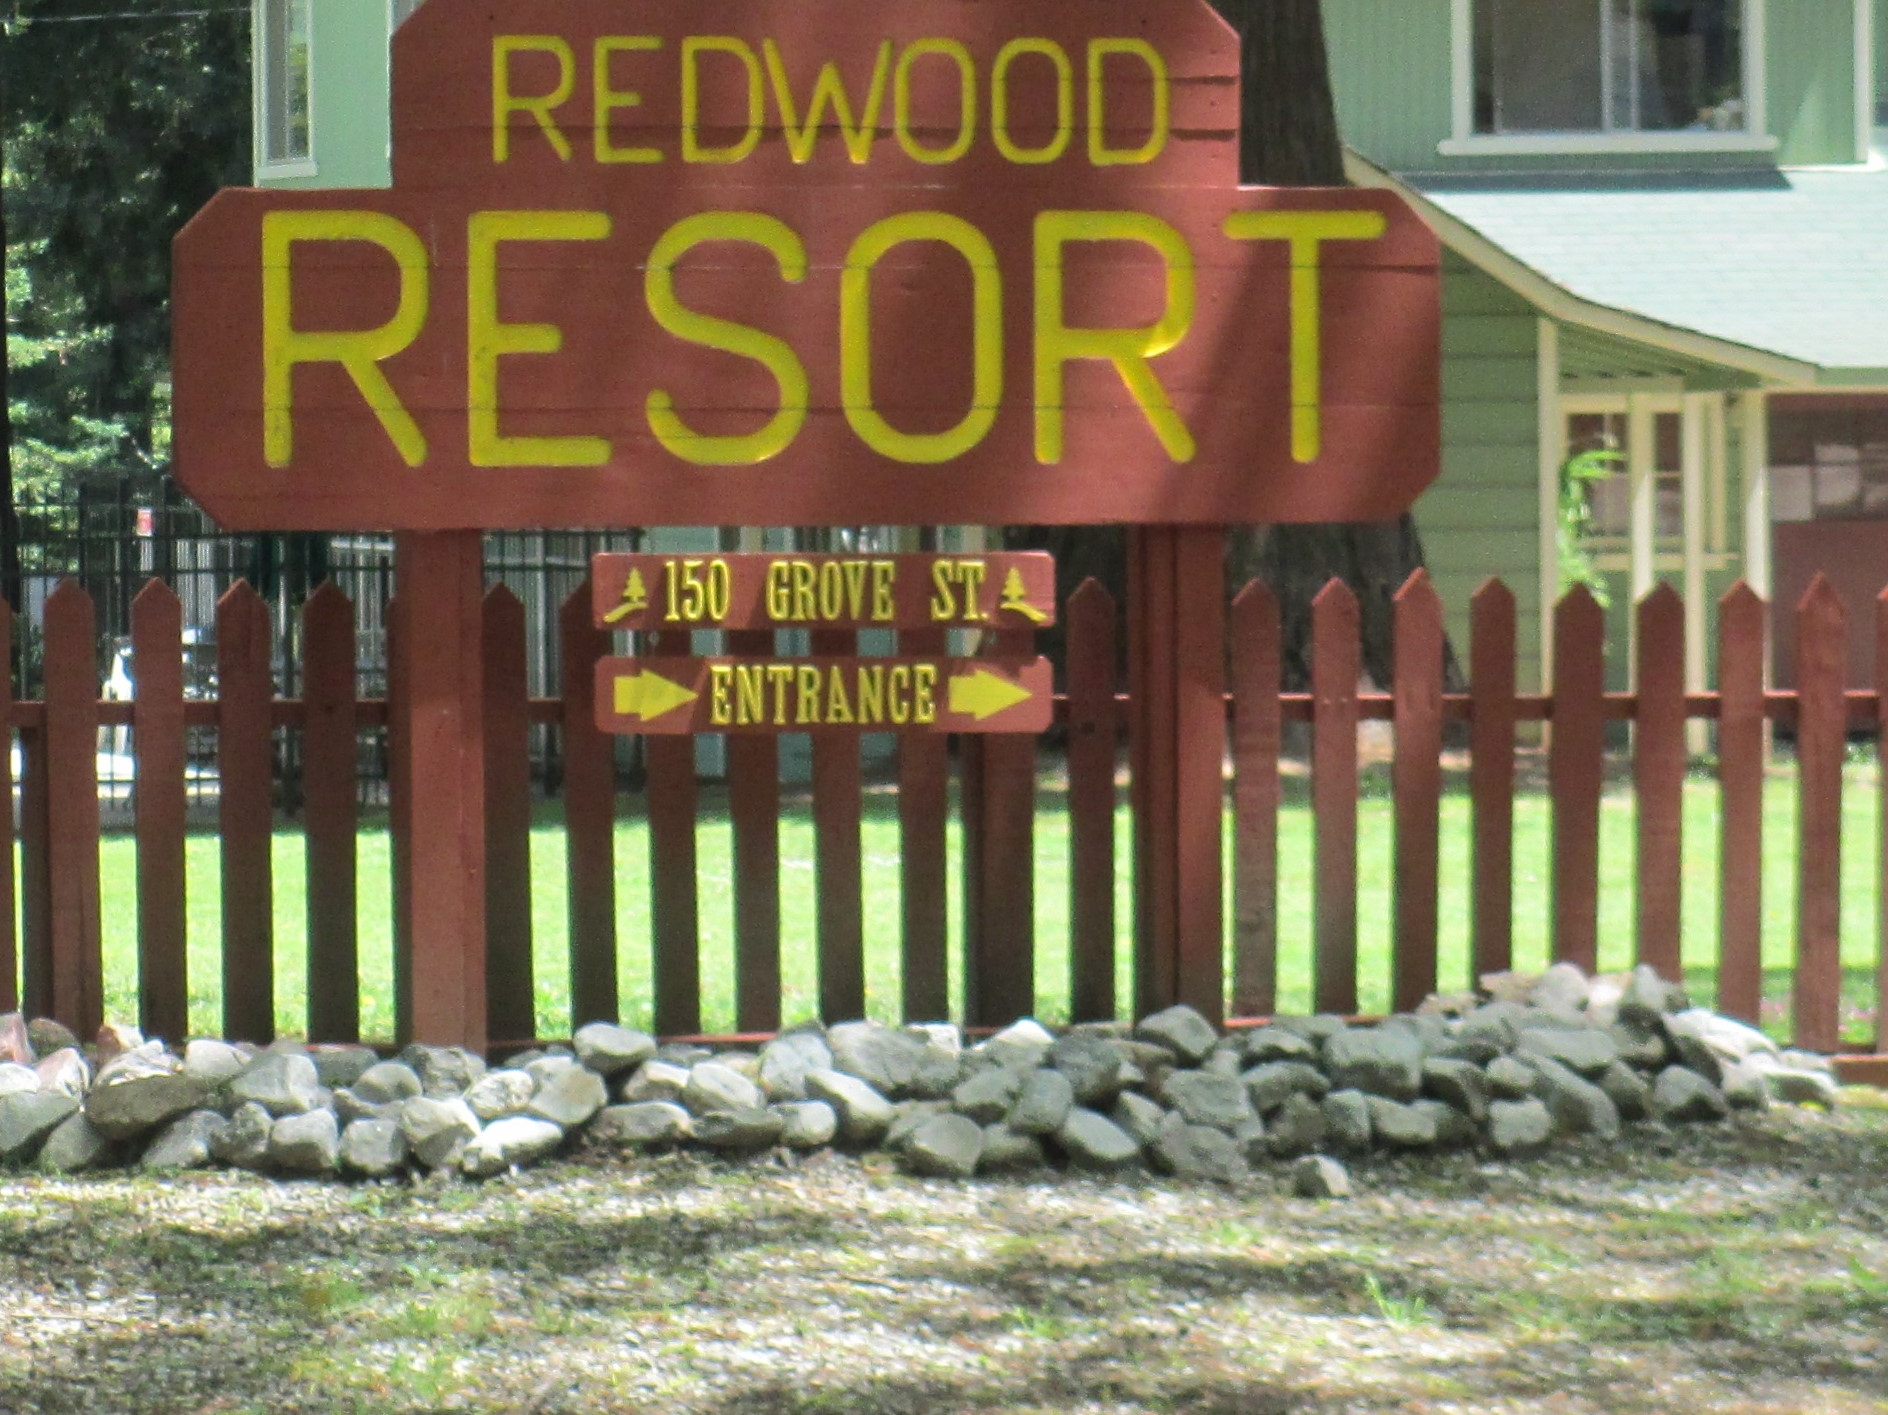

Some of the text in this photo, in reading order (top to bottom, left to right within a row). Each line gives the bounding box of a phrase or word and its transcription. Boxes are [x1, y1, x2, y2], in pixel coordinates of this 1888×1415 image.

[492, 33, 1170, 167] REDWOOD
[261, 210, 1388, 469] RESORT
[664, 558, 988, 622] 150 GROVE ST.
[709, 664, 938, 725] ENTRANCE
